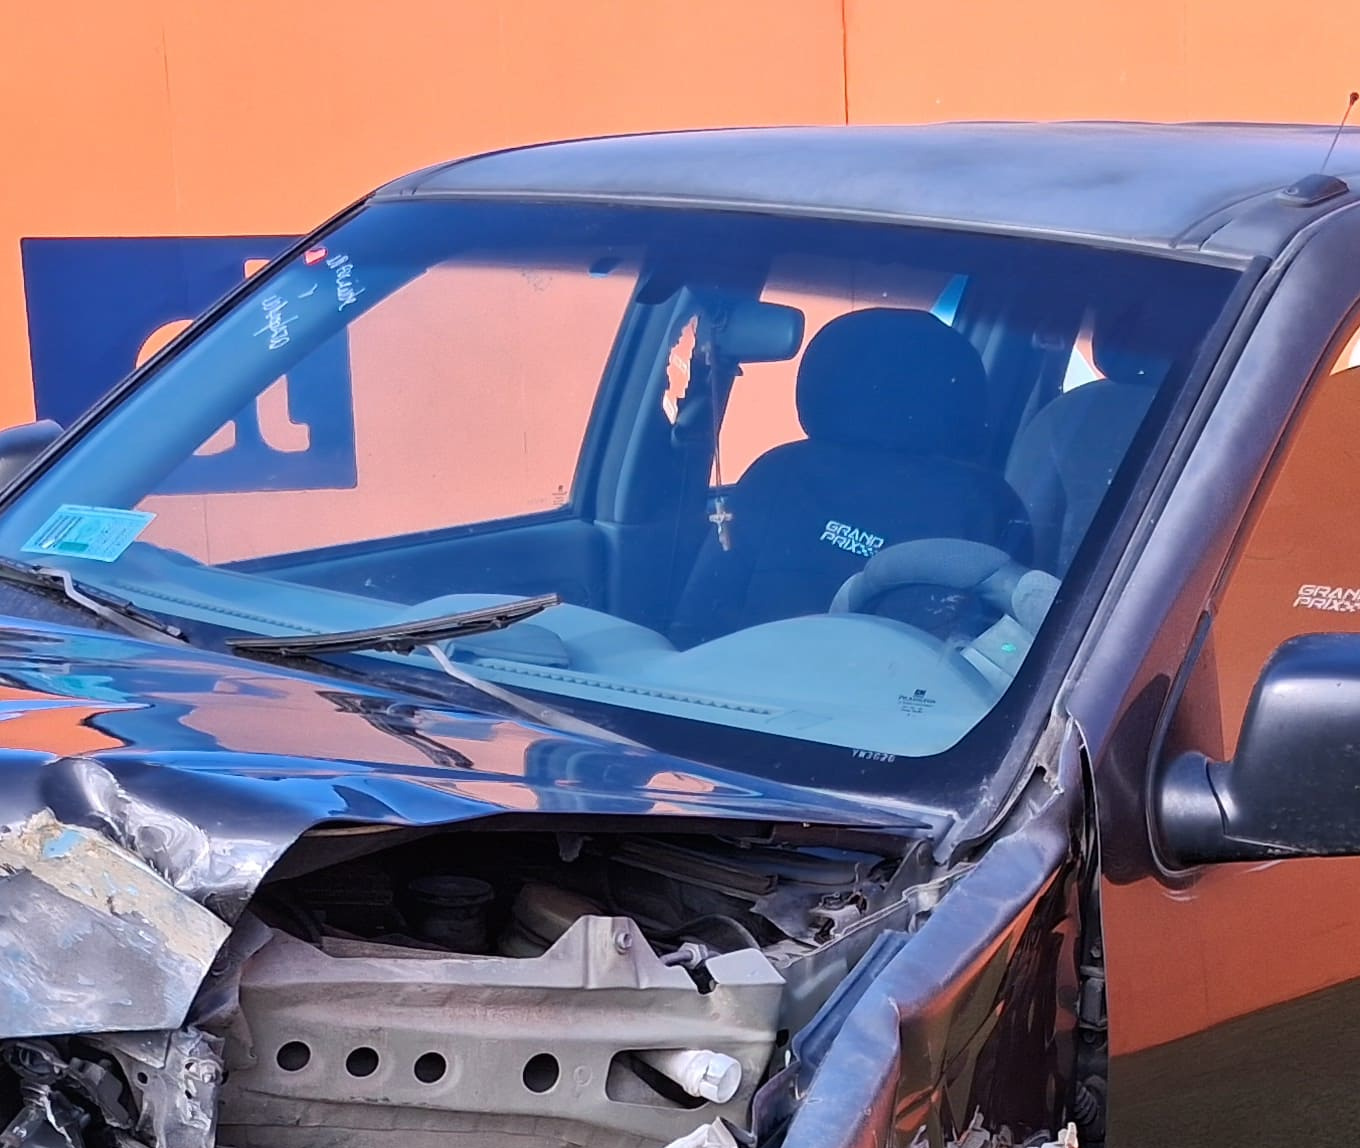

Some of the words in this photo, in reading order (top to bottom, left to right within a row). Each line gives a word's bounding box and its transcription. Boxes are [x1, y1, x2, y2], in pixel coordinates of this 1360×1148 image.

[820, 531, 866, 555] PRIX
[825, 520, 884, 548] GRAND
[1292, 596, 1348, 611] PRIX
